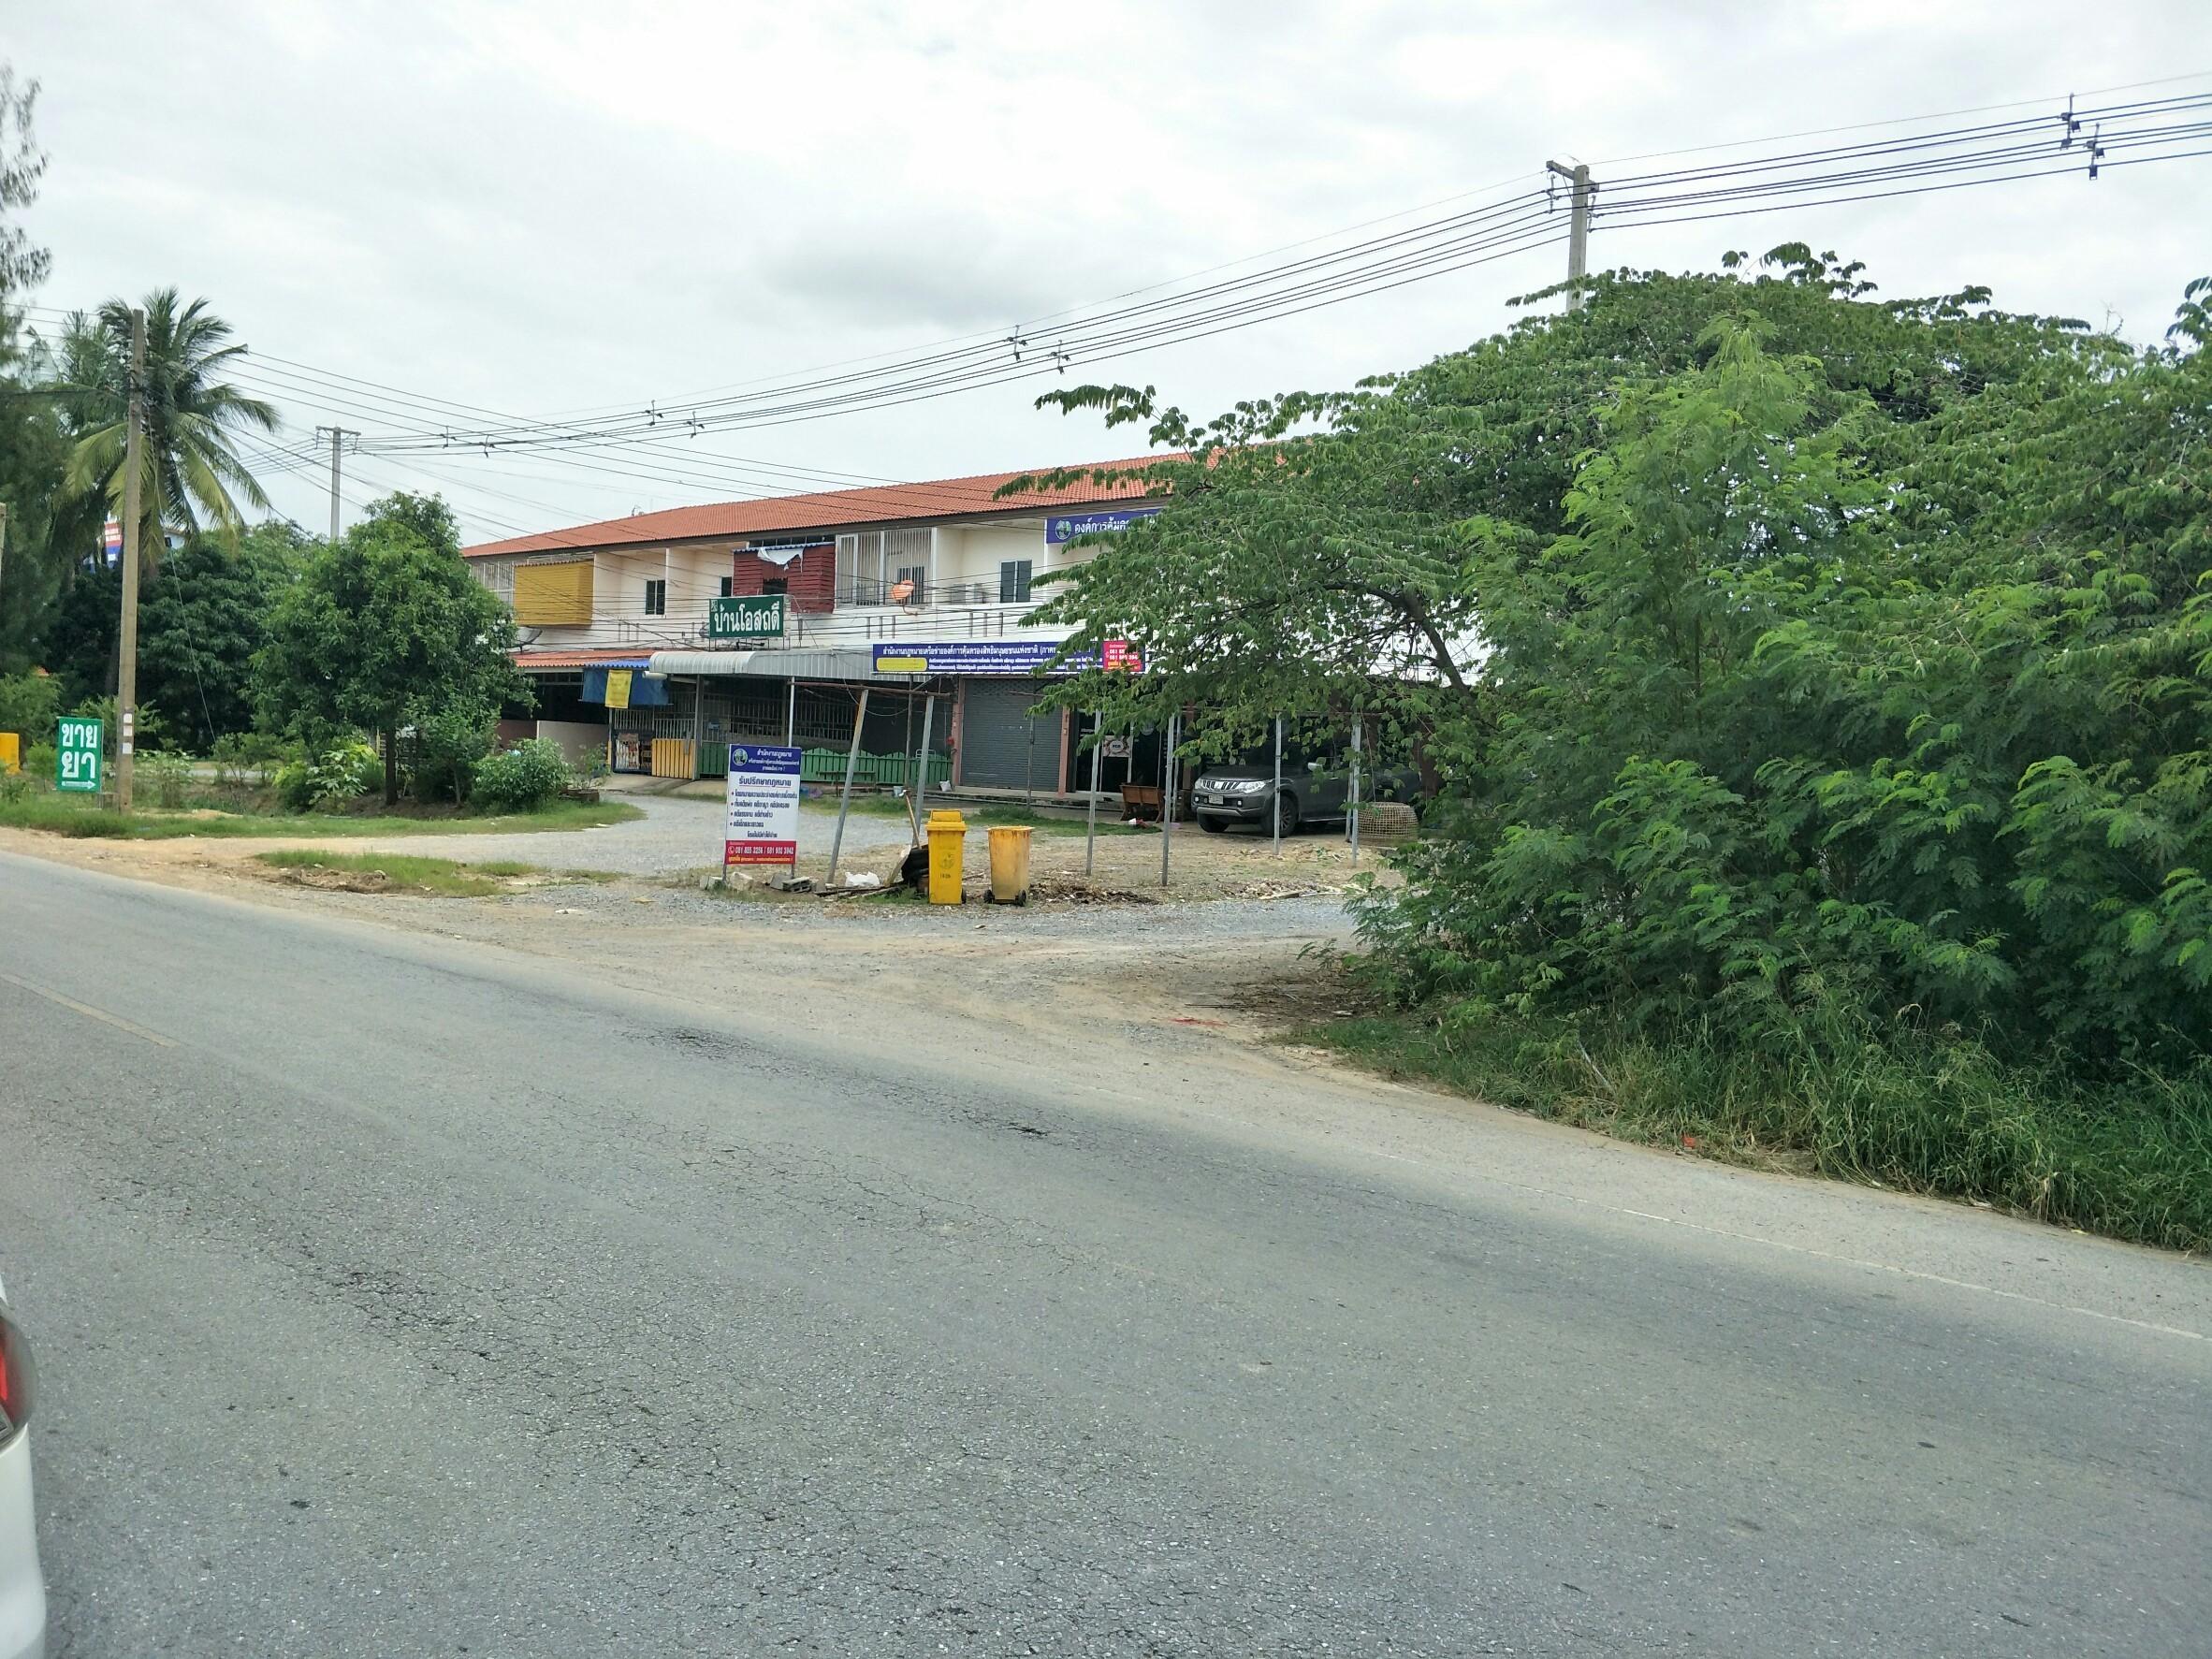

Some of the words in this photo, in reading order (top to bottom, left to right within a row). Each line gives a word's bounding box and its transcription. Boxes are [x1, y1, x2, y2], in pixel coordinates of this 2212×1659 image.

[714, 601, 780, 633] บ้านโอสถดี
[61, 723, 97, 748] ขาย
[61, 751, 96, 779] ยา
[739, 776, 792, 787] รับปรึกษากฎหมาย
